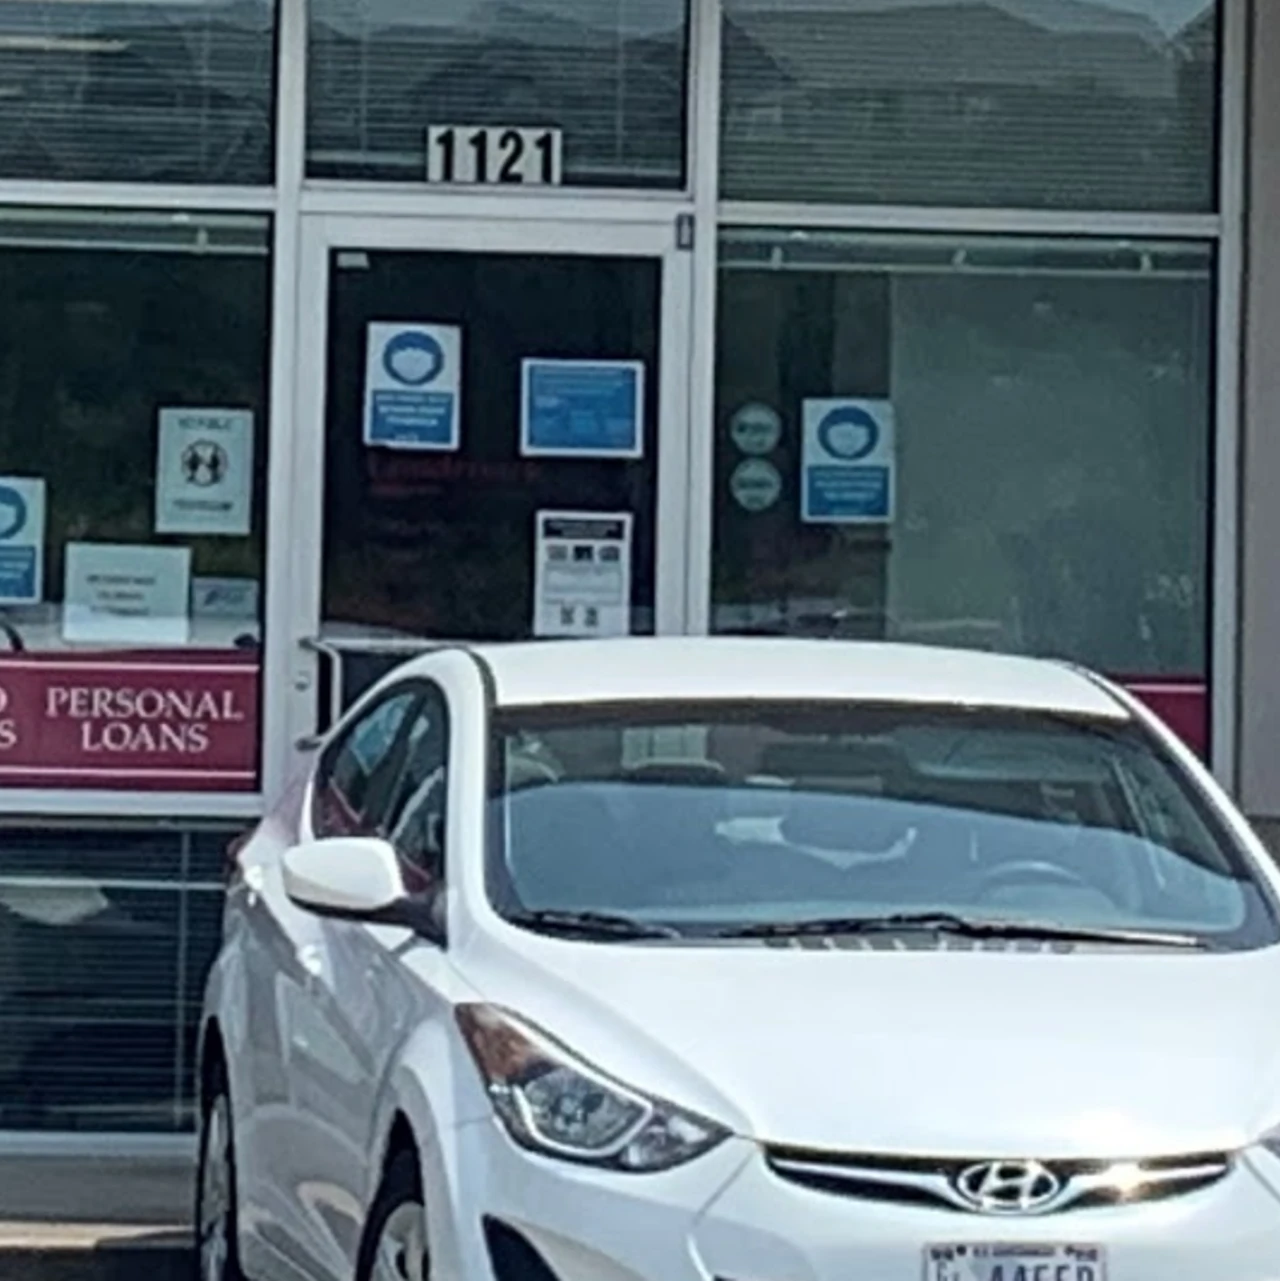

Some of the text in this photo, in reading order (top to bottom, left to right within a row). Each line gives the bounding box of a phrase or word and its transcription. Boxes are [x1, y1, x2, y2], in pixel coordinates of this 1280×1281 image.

[436, 128, 553, 184] 1121
[46, 687, 243, 720] PERSONAL
[81, 722, 209, 754] LOANS
